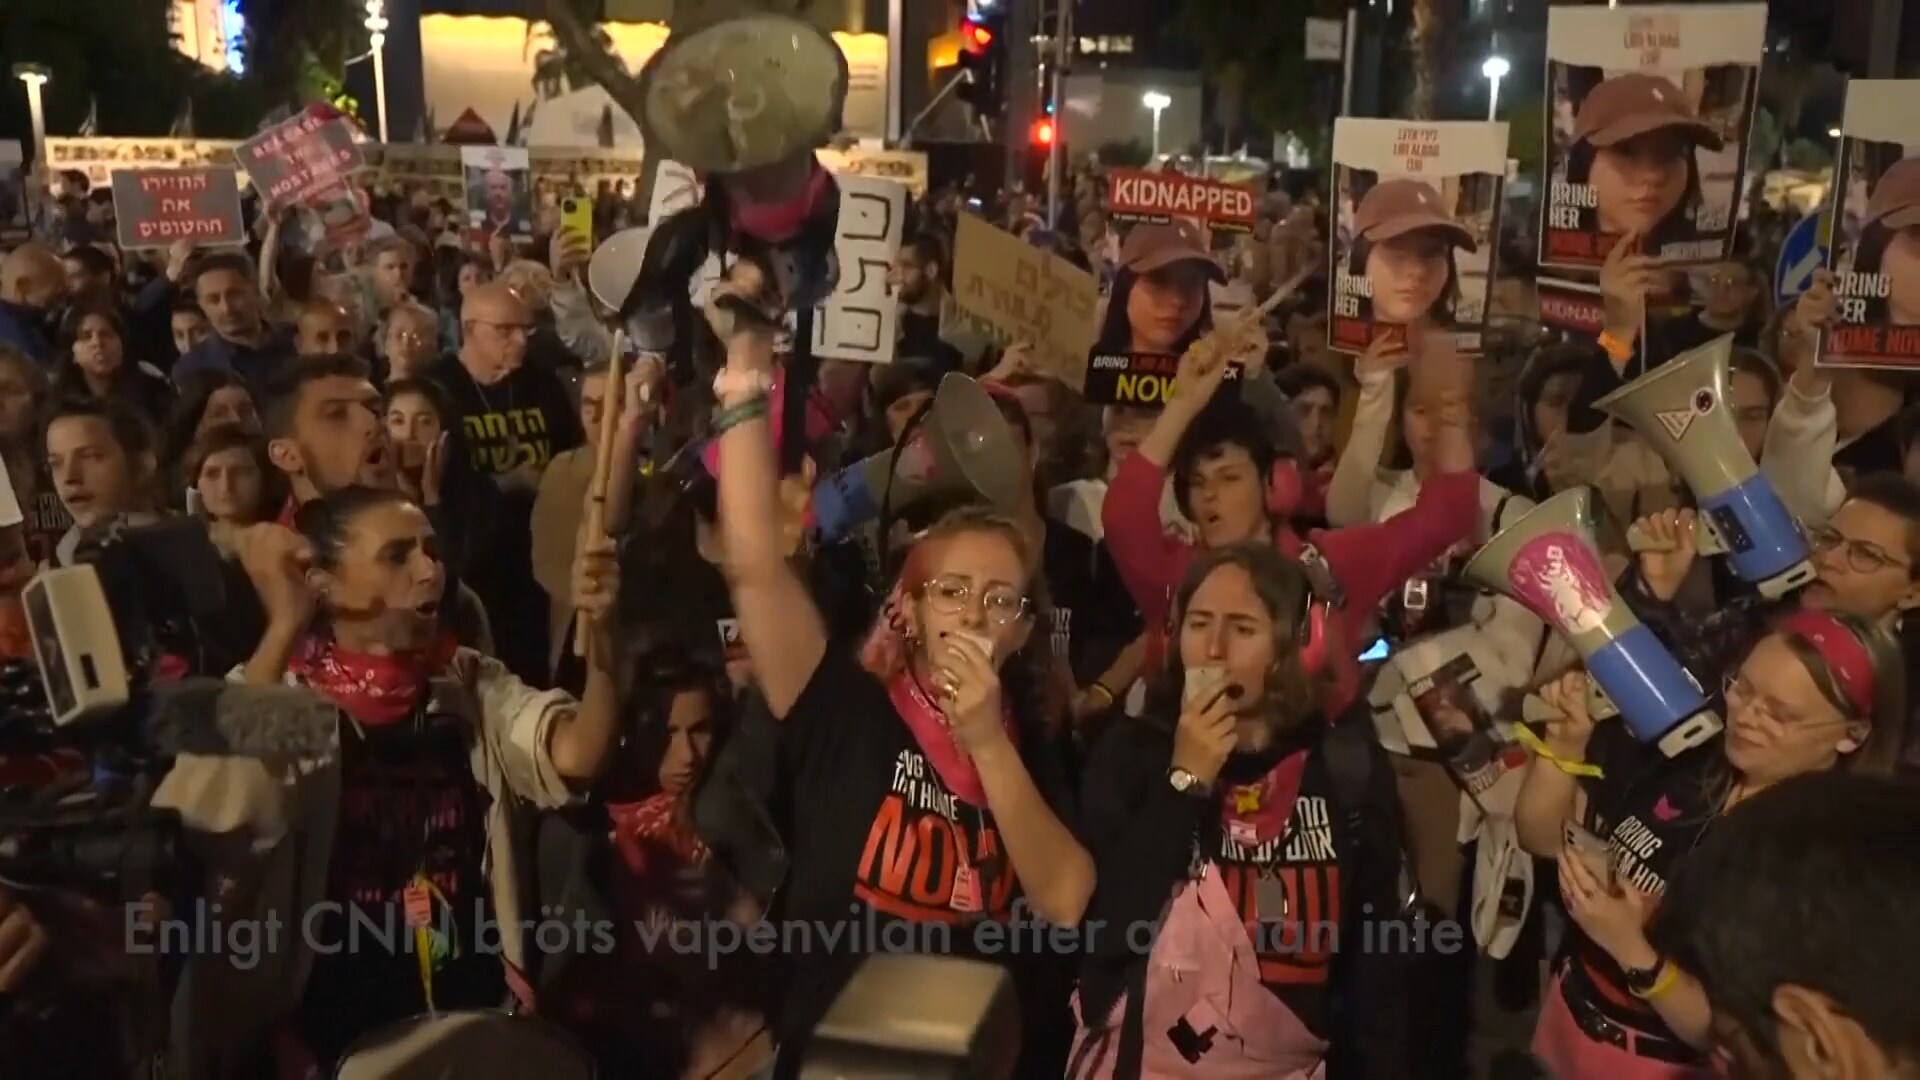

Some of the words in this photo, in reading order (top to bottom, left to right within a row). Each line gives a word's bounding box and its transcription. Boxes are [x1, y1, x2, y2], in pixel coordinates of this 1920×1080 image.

[141, 174, 206, 191] החזירו
[162, 198, 190, 212] את
[1114, 177, 1253, 216] KIDNAPPED
[1552, 183, 1597, 207] BRING
[139, 219, 222, 237] החטופים
[1550, 206, 1579, 229] HER
[1337, 274, 1374, 298] BRING
[1335, 295, 1360, 318] HER
[1541, 300, 1602, 322] KIDNAP
[1838, 298, 1868, 324] ER
[1887, 328, 1920, 353] NO
[1093, 355, 1129, 370] BRING
[1613, 815, 1663, 860] BRING
[1631, 862, 1665, 897] HO
